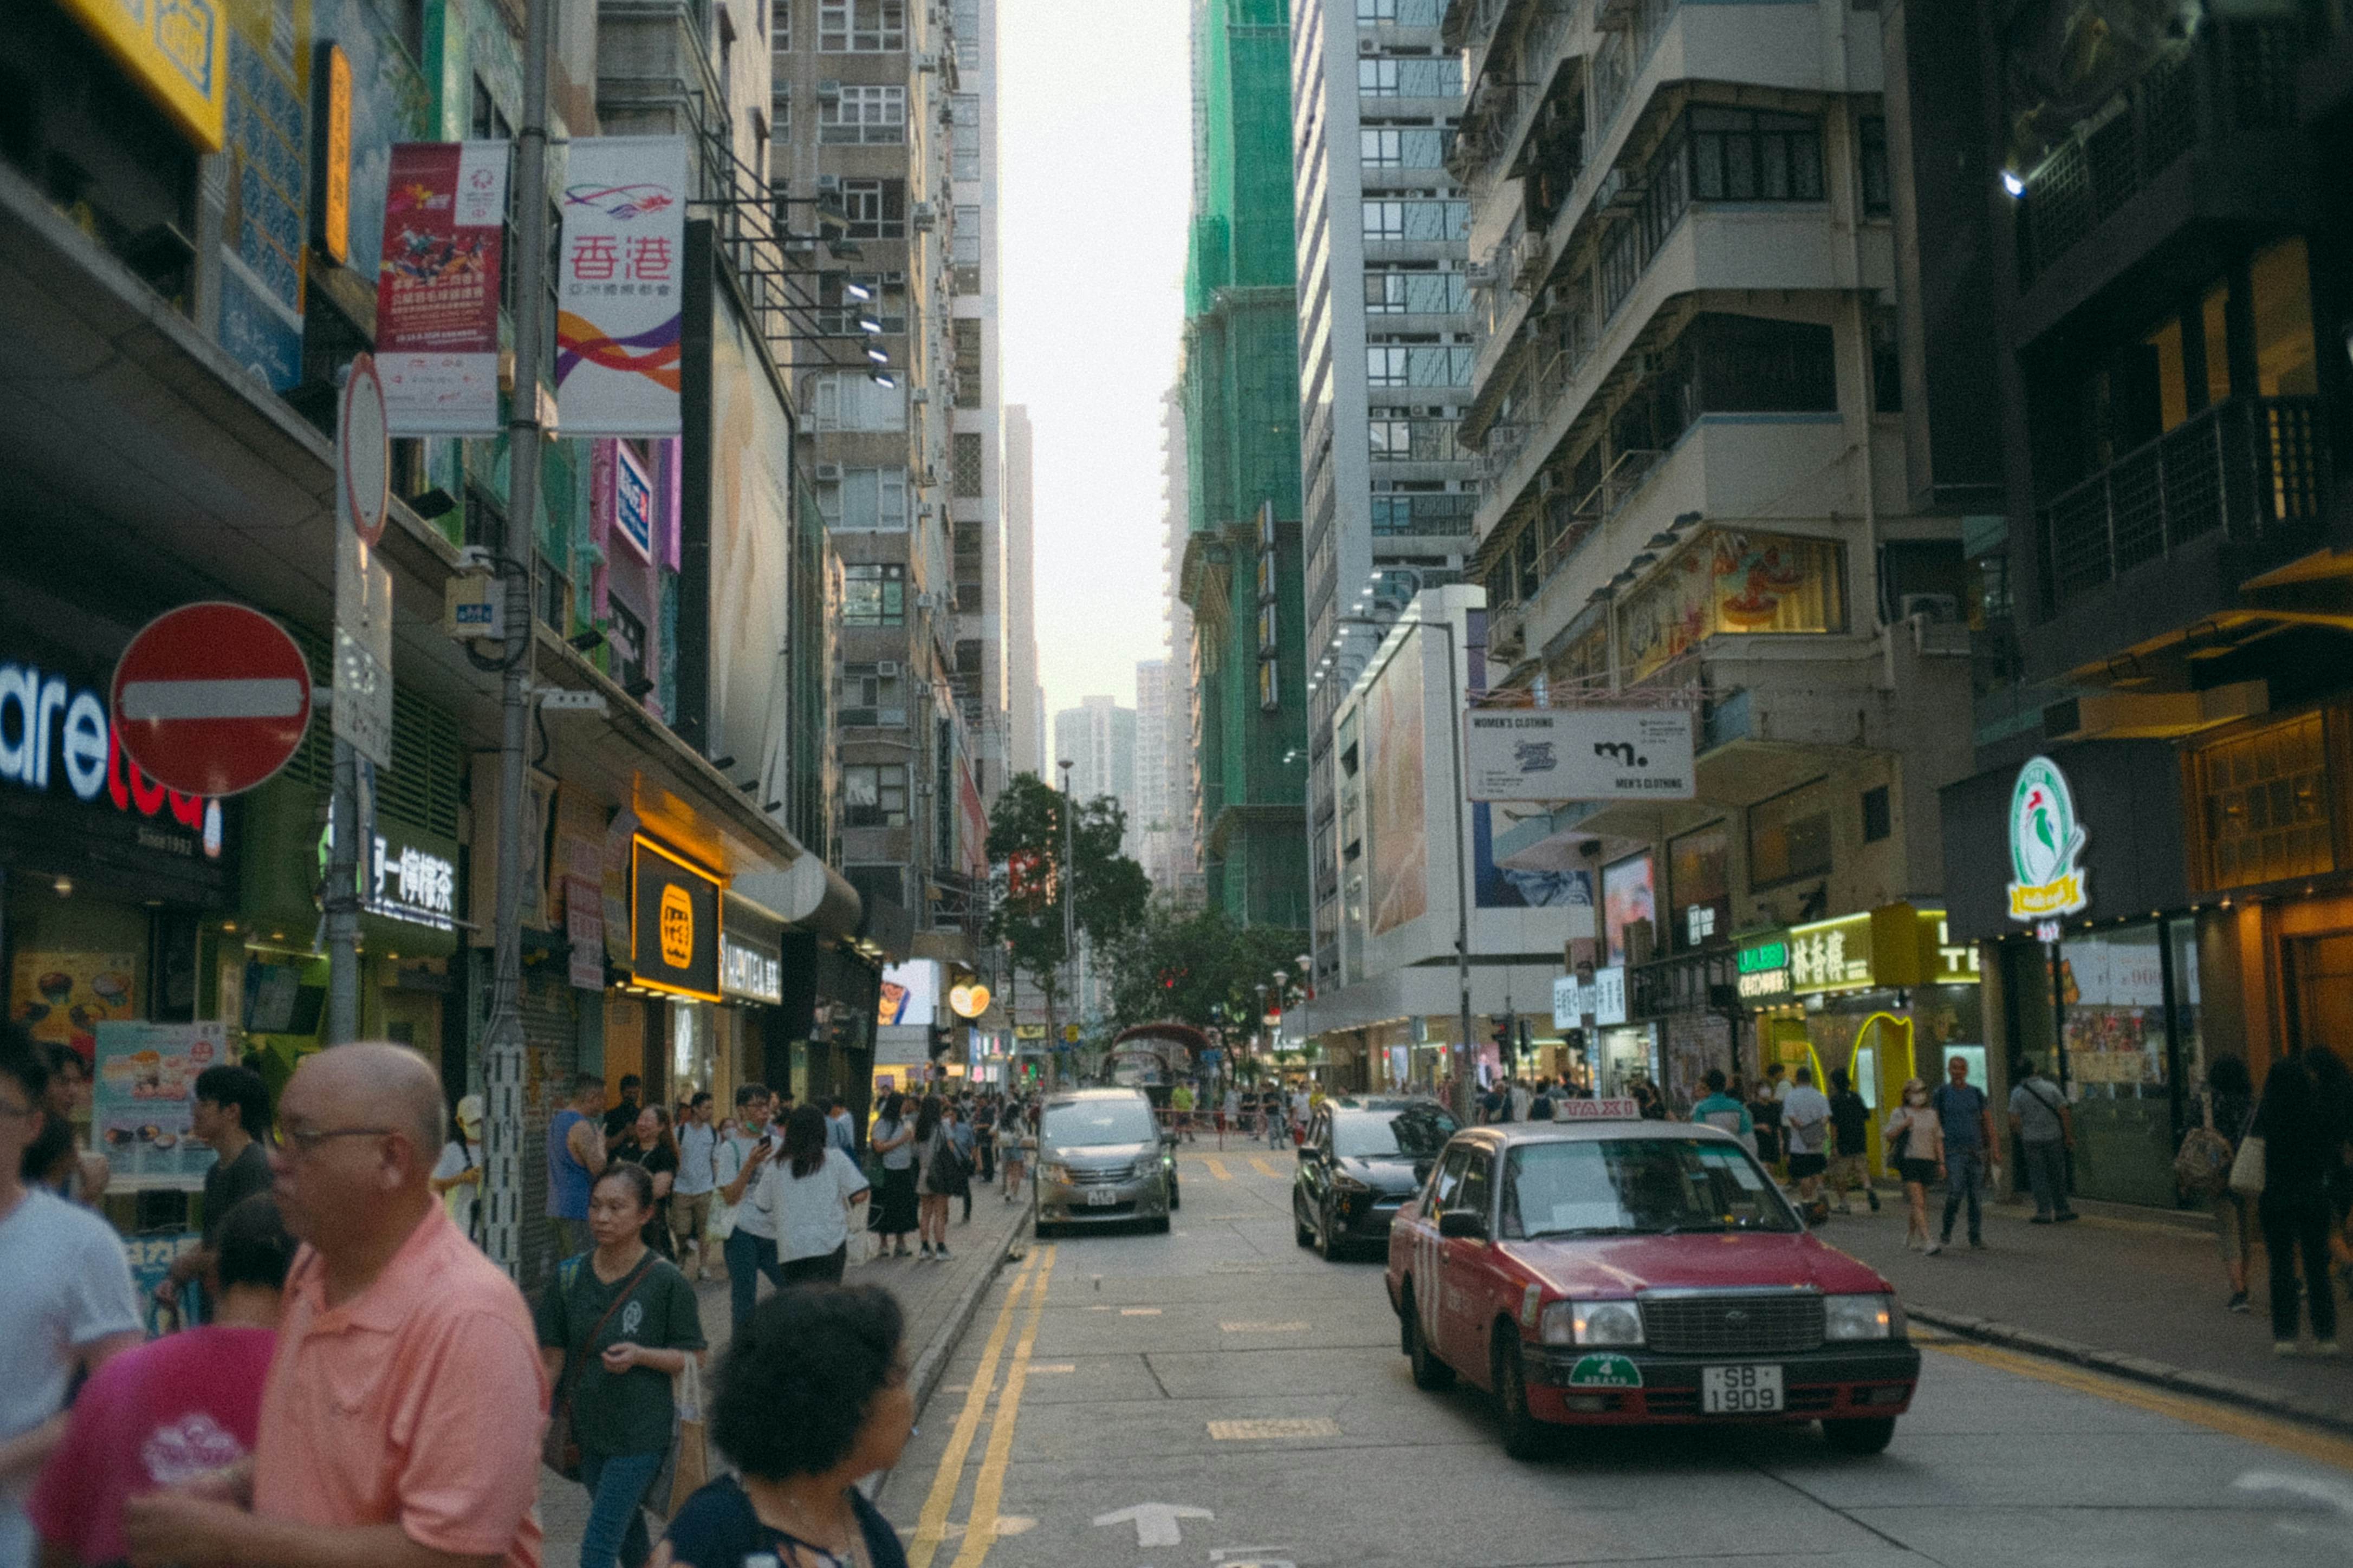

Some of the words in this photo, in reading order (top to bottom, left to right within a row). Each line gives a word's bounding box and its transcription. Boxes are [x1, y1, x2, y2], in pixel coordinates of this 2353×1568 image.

[571, 236, 672, 280] 香港
[1473, 717, 1512, 728] WOMEN'S
[1515, 717, 1554, 728] CLOTHING
[1615, 778, 1642, 789] MEN'S
[1643, 778, 1683, 789] CLOTHING
[1564, 1100, 1633, 1116] TAXI
[1598, 1362, 1613, 1375] 4
[1724, 1368, 1755, 1387] SB
[1712, 1388, 1774, 1411] 1909
